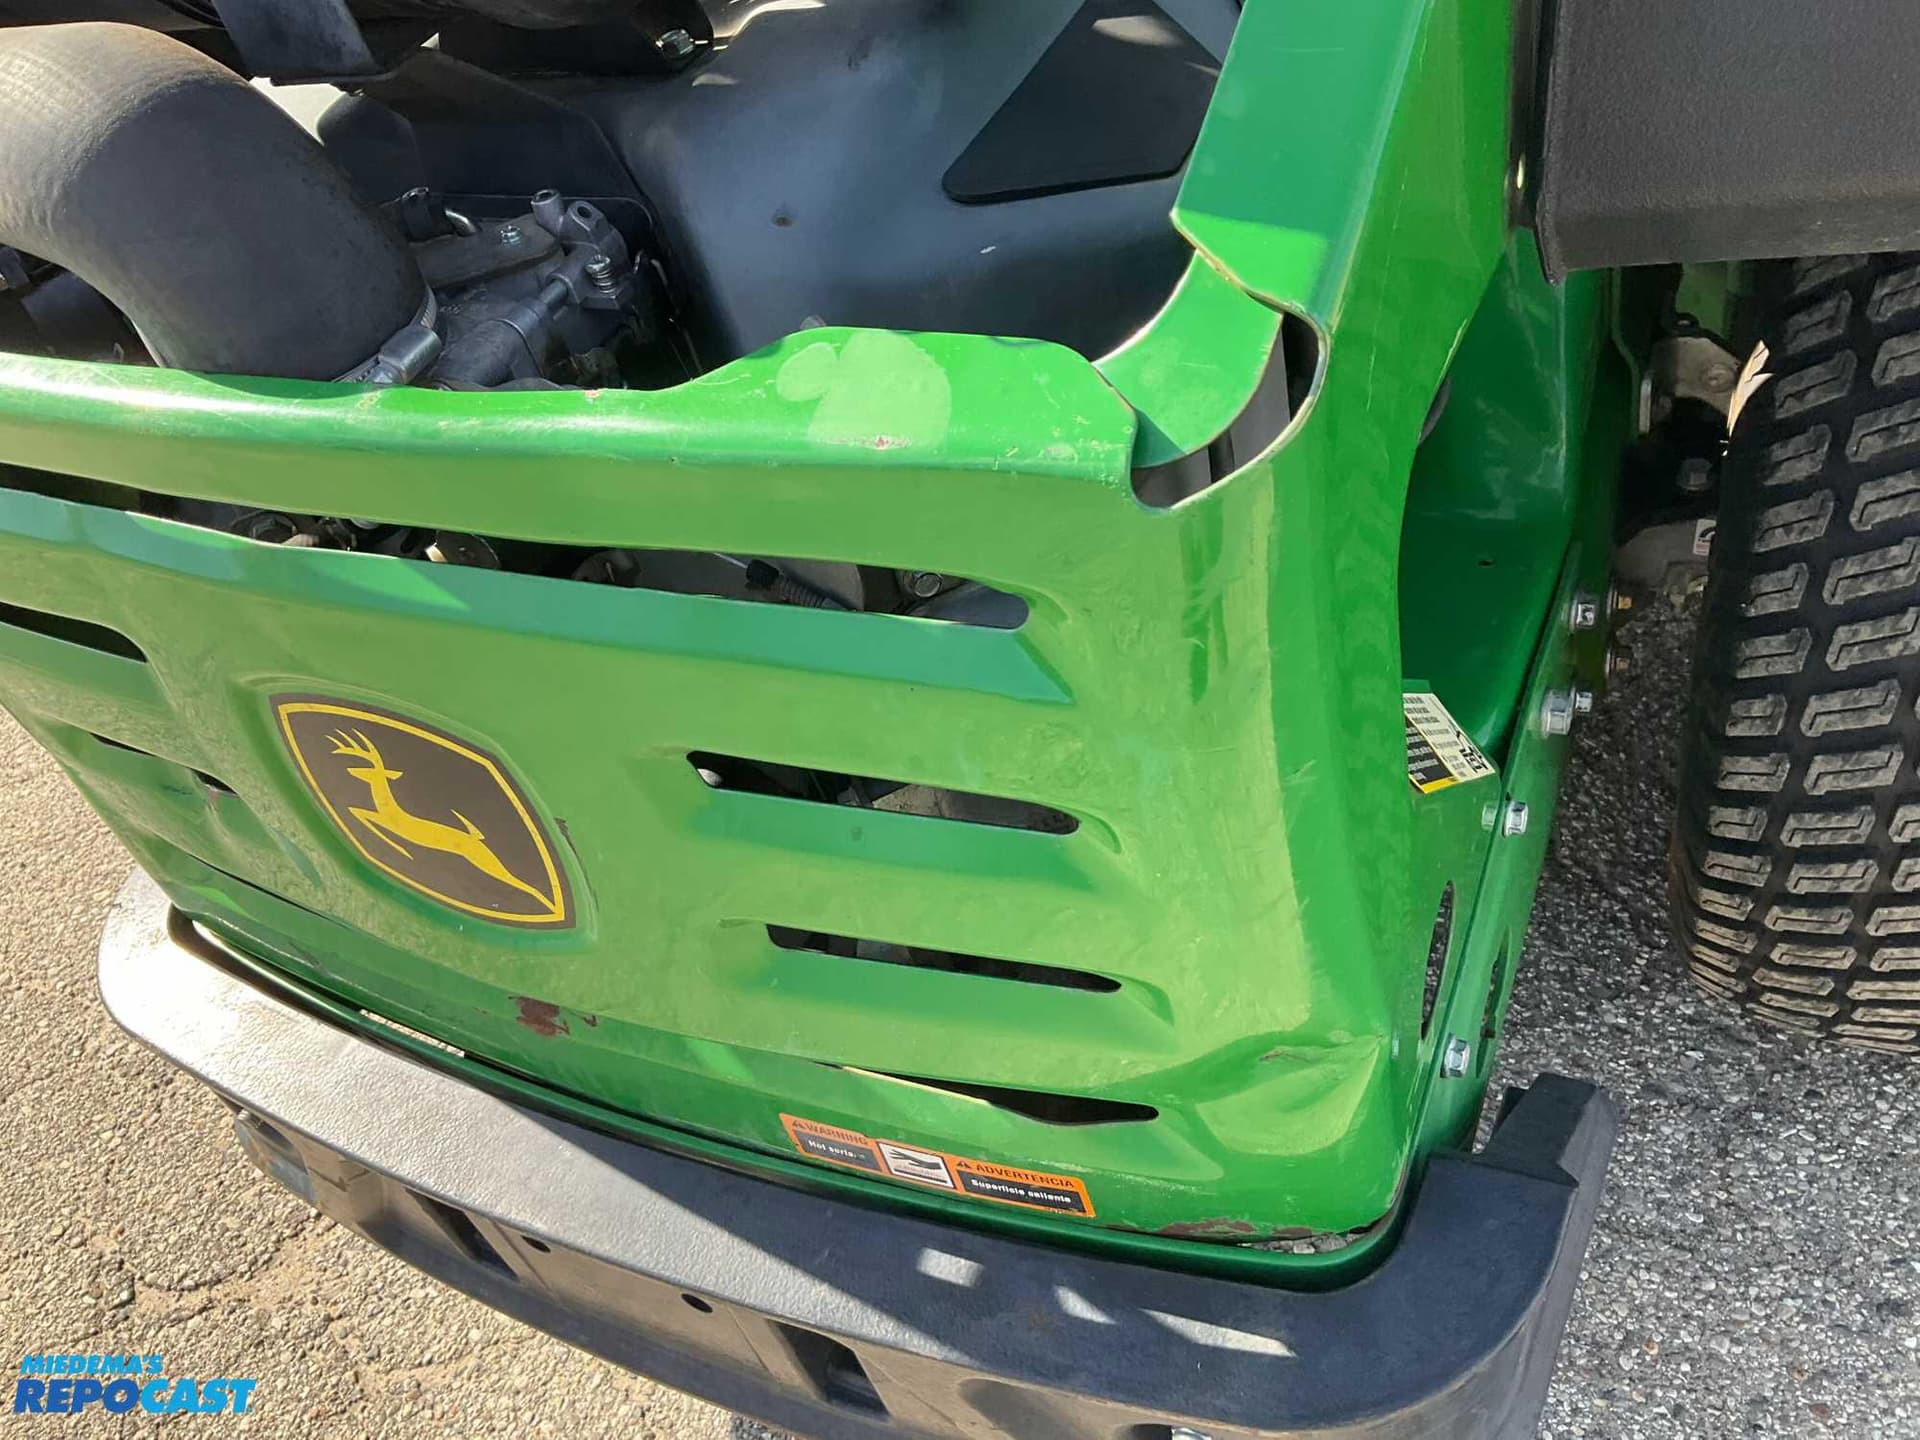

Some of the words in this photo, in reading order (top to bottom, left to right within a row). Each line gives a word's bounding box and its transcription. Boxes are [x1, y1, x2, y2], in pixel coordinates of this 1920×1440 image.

[806, 1123, 869, 1145] WARNING
[976, 1164, 1074, 1188] ADVERTENCIA
[970, 1178, 1025, 1196] Superficie
[1028, 1190, 1072, 1203] caliente
